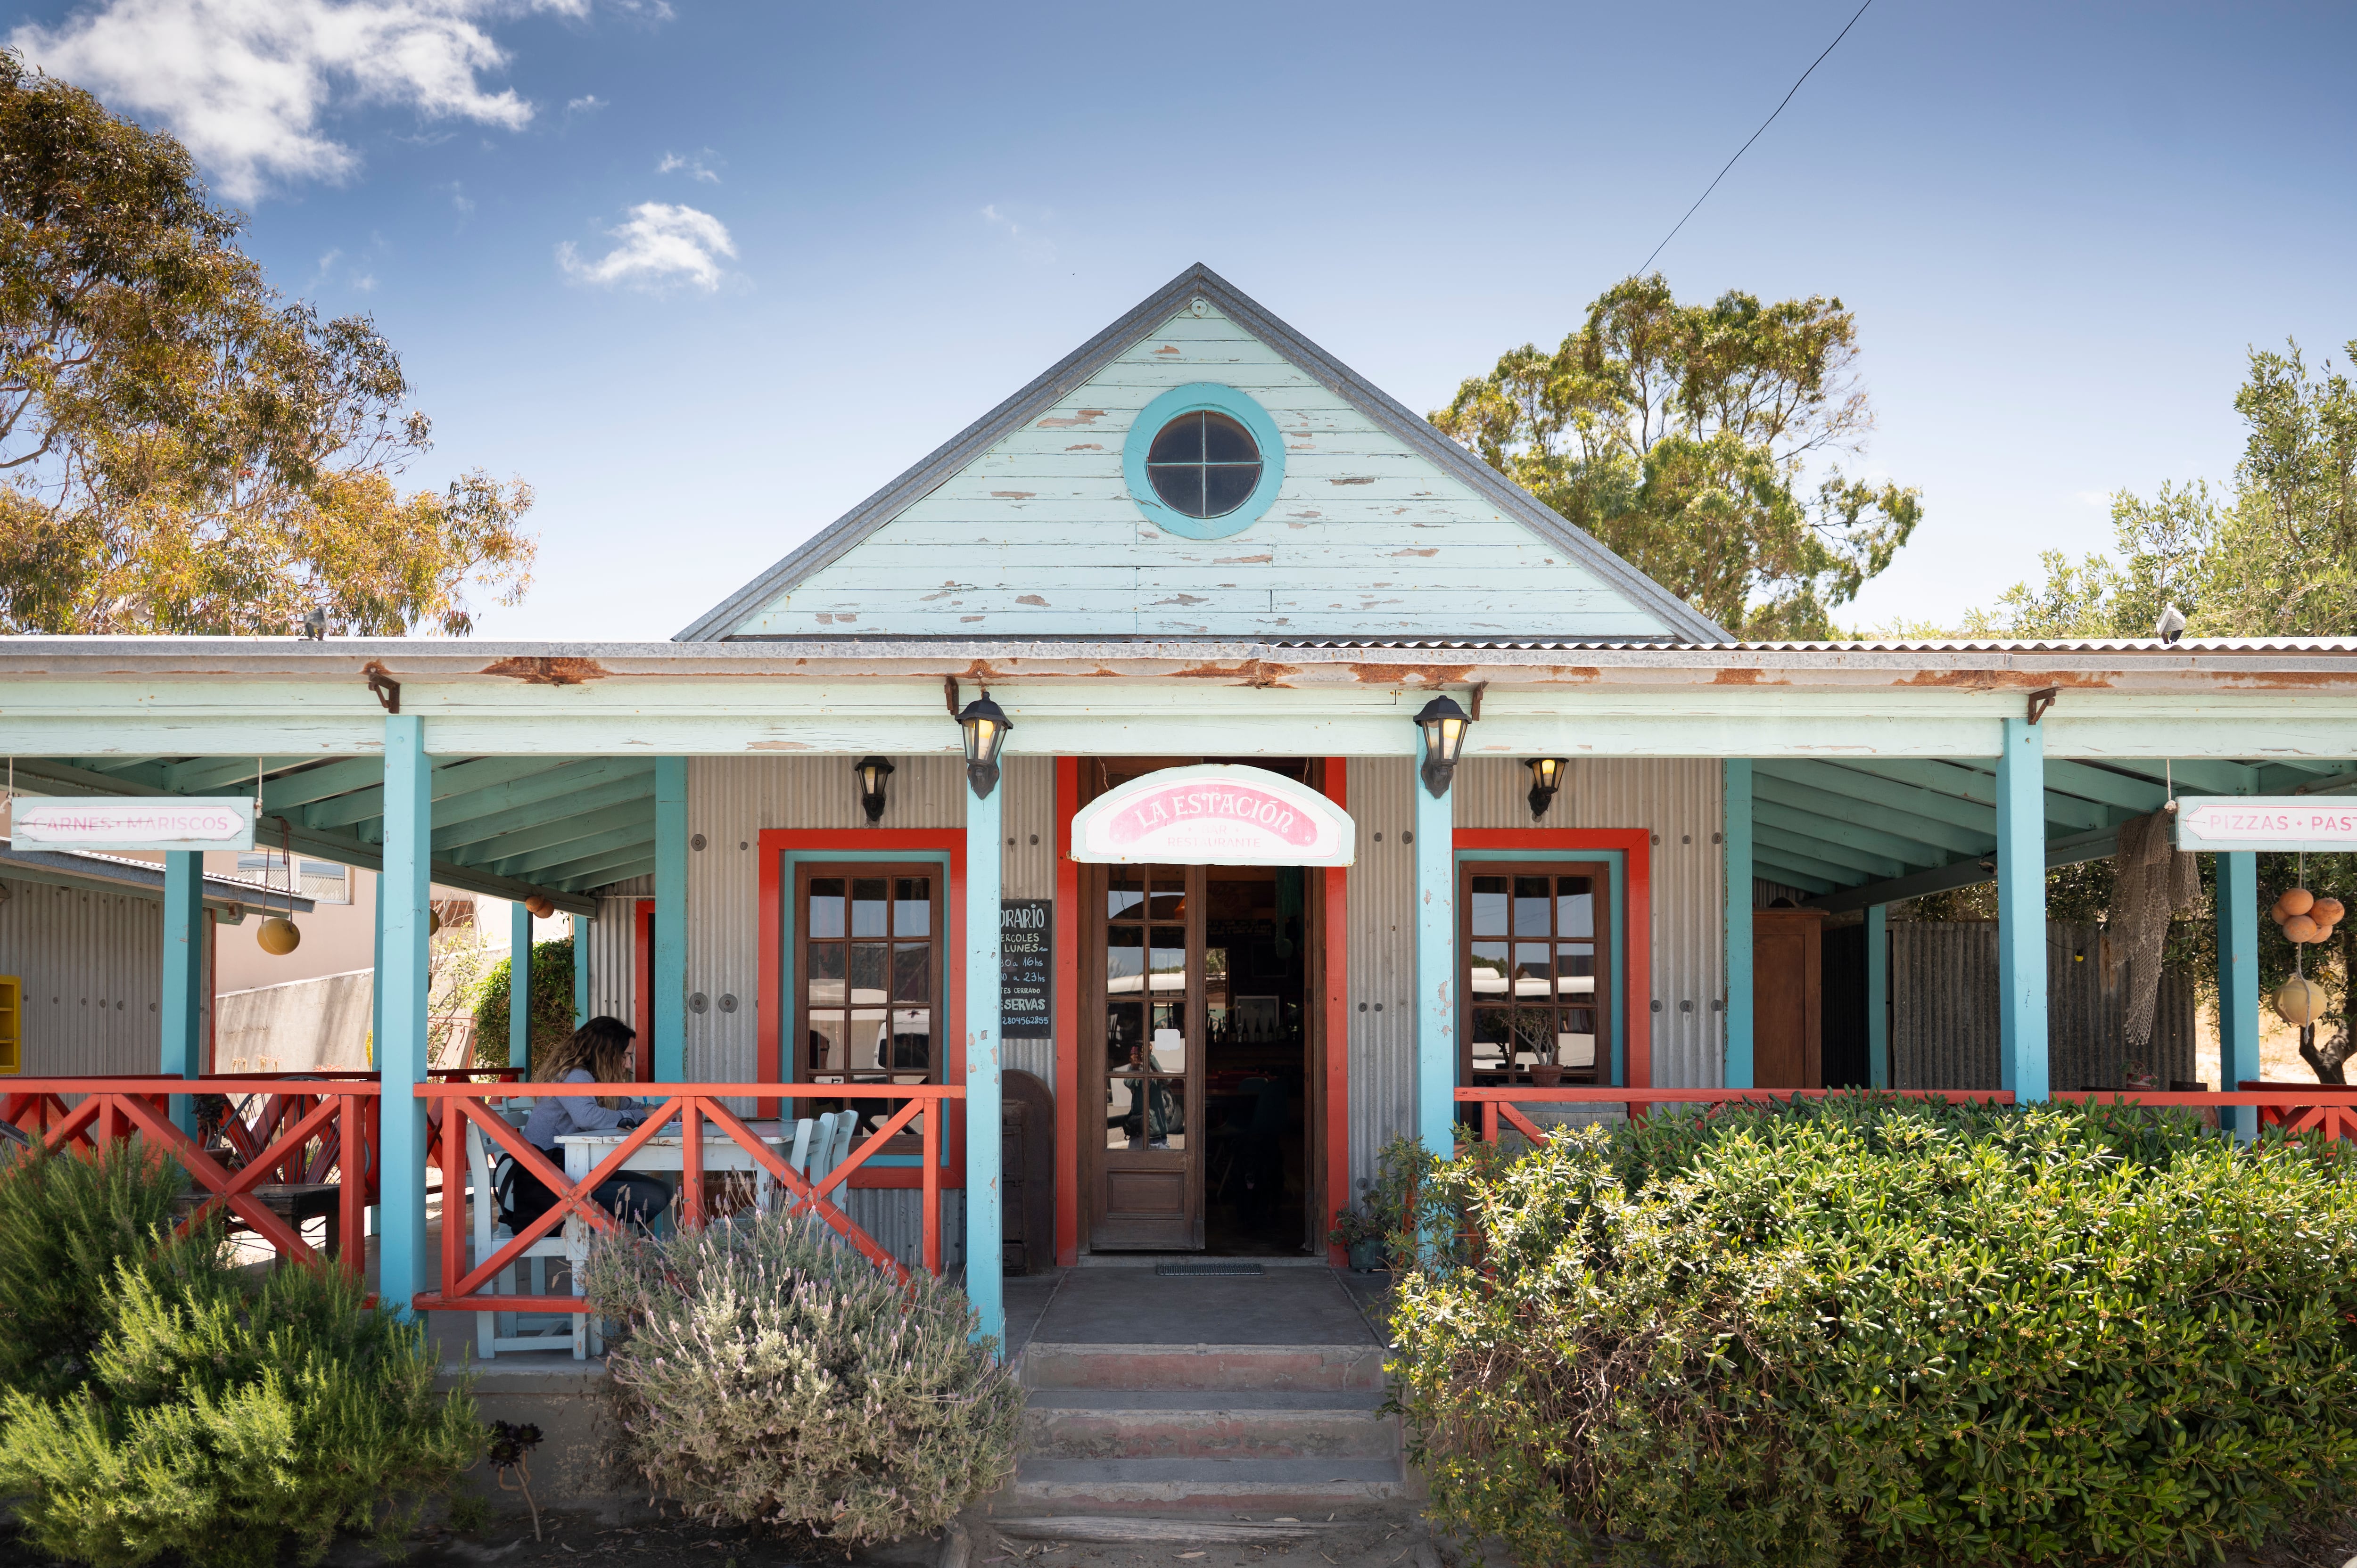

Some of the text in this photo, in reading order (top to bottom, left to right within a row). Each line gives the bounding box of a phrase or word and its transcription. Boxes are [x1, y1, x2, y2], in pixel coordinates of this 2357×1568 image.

[1134, 801, 1169, 828] LA
[33, 816, 228, 831] CARNES MARISCOS
[2210, 815, 2289, 830] PIZZAS
[1202, 825, 1227, 834] BAR
[1168, 837, 1261, 847] RESTAURANTE
[1005, 944, 1038, 952] LUNES
[1002, 1016, 1049, 1025] 2804562855
